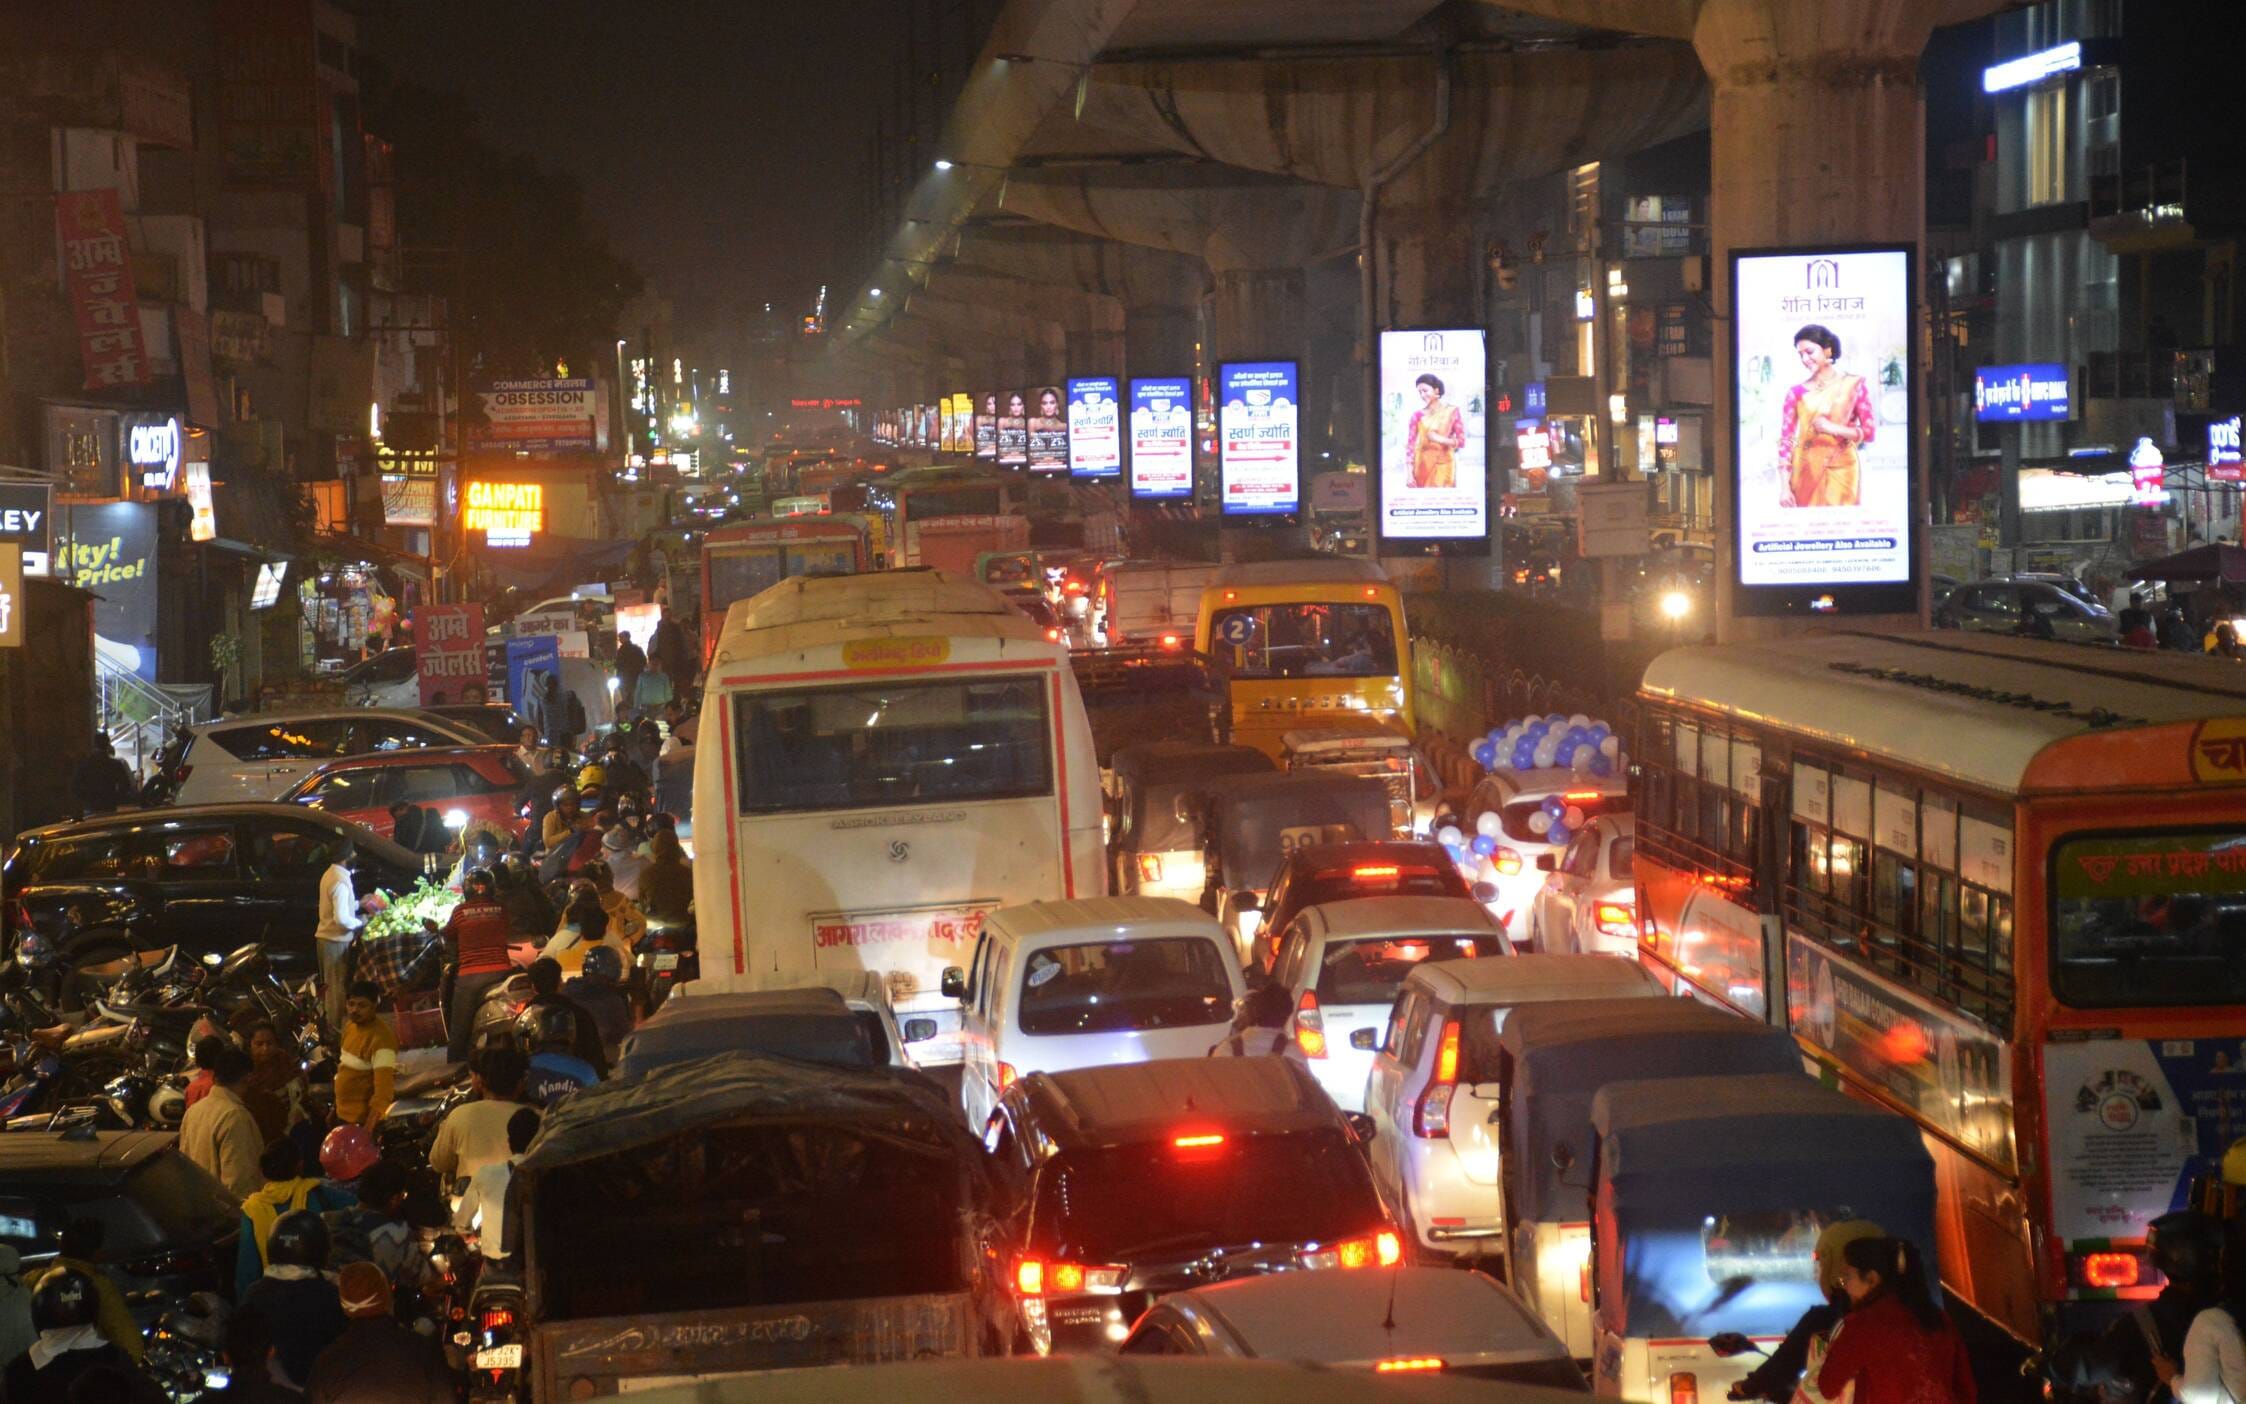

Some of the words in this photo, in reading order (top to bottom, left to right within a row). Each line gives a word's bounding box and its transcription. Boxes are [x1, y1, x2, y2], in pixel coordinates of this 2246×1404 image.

[493, 380, 552, 389] COMMERCE
[495, 391, 584, 405] OBSESSION
[1229, 423, 1255, 439] स्वर्ण
[1258, 423, 1290, 439] ज्योति
[468, 481, 542, 509] GANPATI
[467, 509, 542, 531] FURNITURE
[1759, 542, 1793, 552] Artificial
[1834, 540, 1852, 550] Also
[1854, 539, 1891, 549] Available
[76, 558, 145, 588] Price!
[427, 607, 470, 641] अम्बे
[1231, 620, 1245, 639] 2
[2166, 848, 2208, 878] प्रदेश
[815, 924, 868, 948] आगरा
